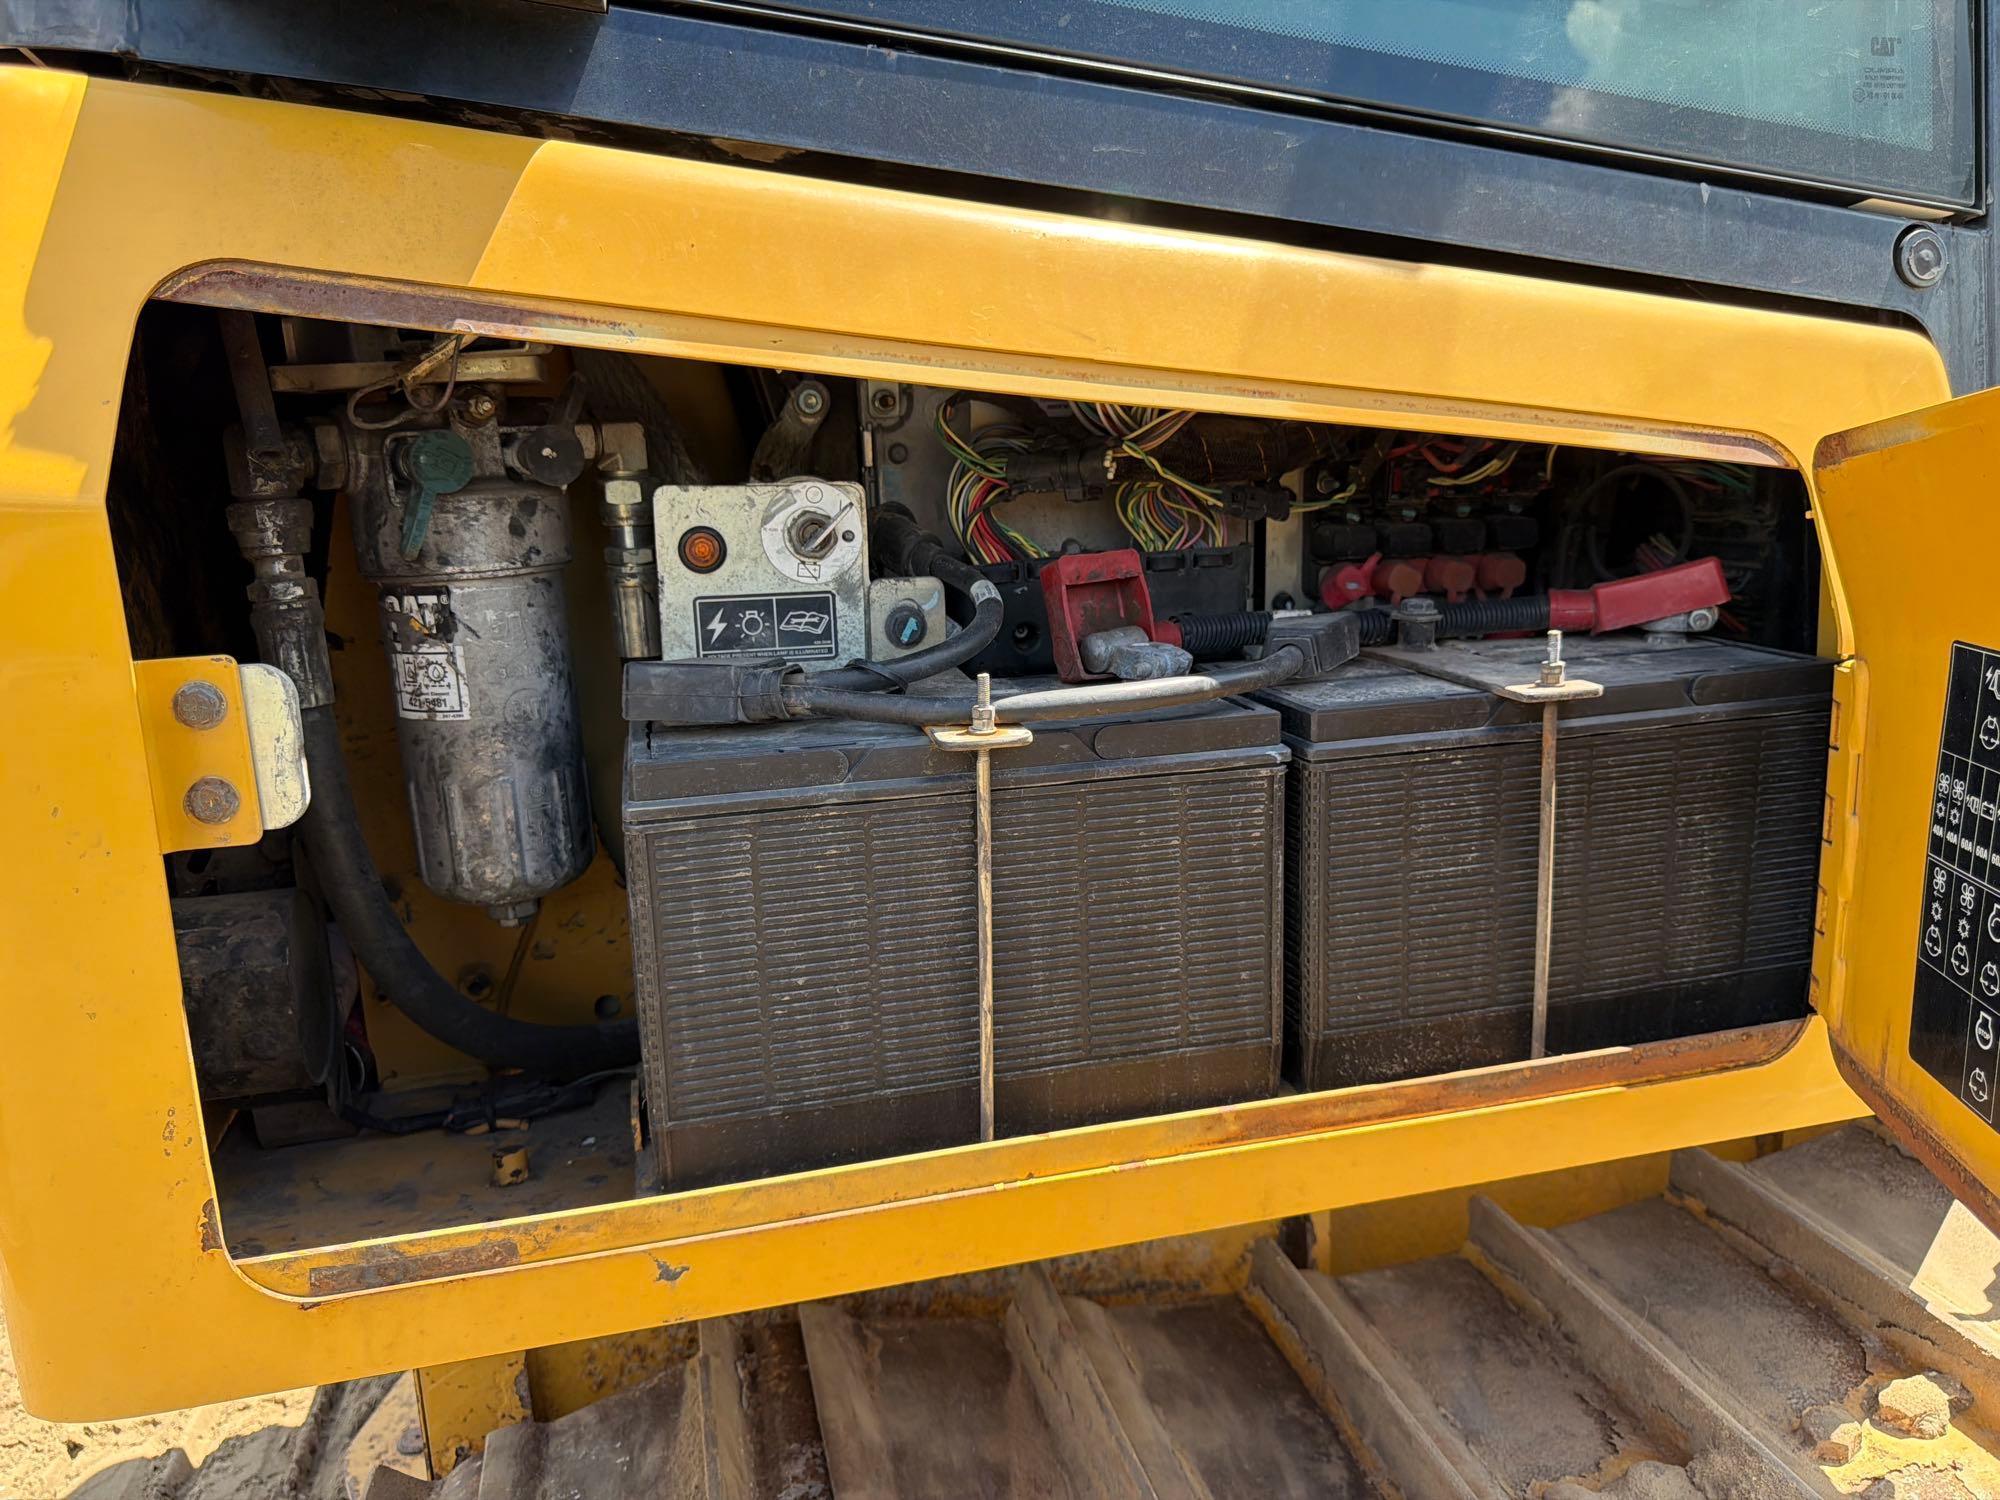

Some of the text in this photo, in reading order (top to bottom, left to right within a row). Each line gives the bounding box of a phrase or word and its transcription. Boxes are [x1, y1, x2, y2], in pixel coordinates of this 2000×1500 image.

[1933, 824, 1943, 838] 40A
[1946, 831, 1957, 845] 40A
[1961, 839, 1972, 853] 60A
[1991, 853, 2000, 868] 60
[1978, 1028, 1990, 1040] STOP
